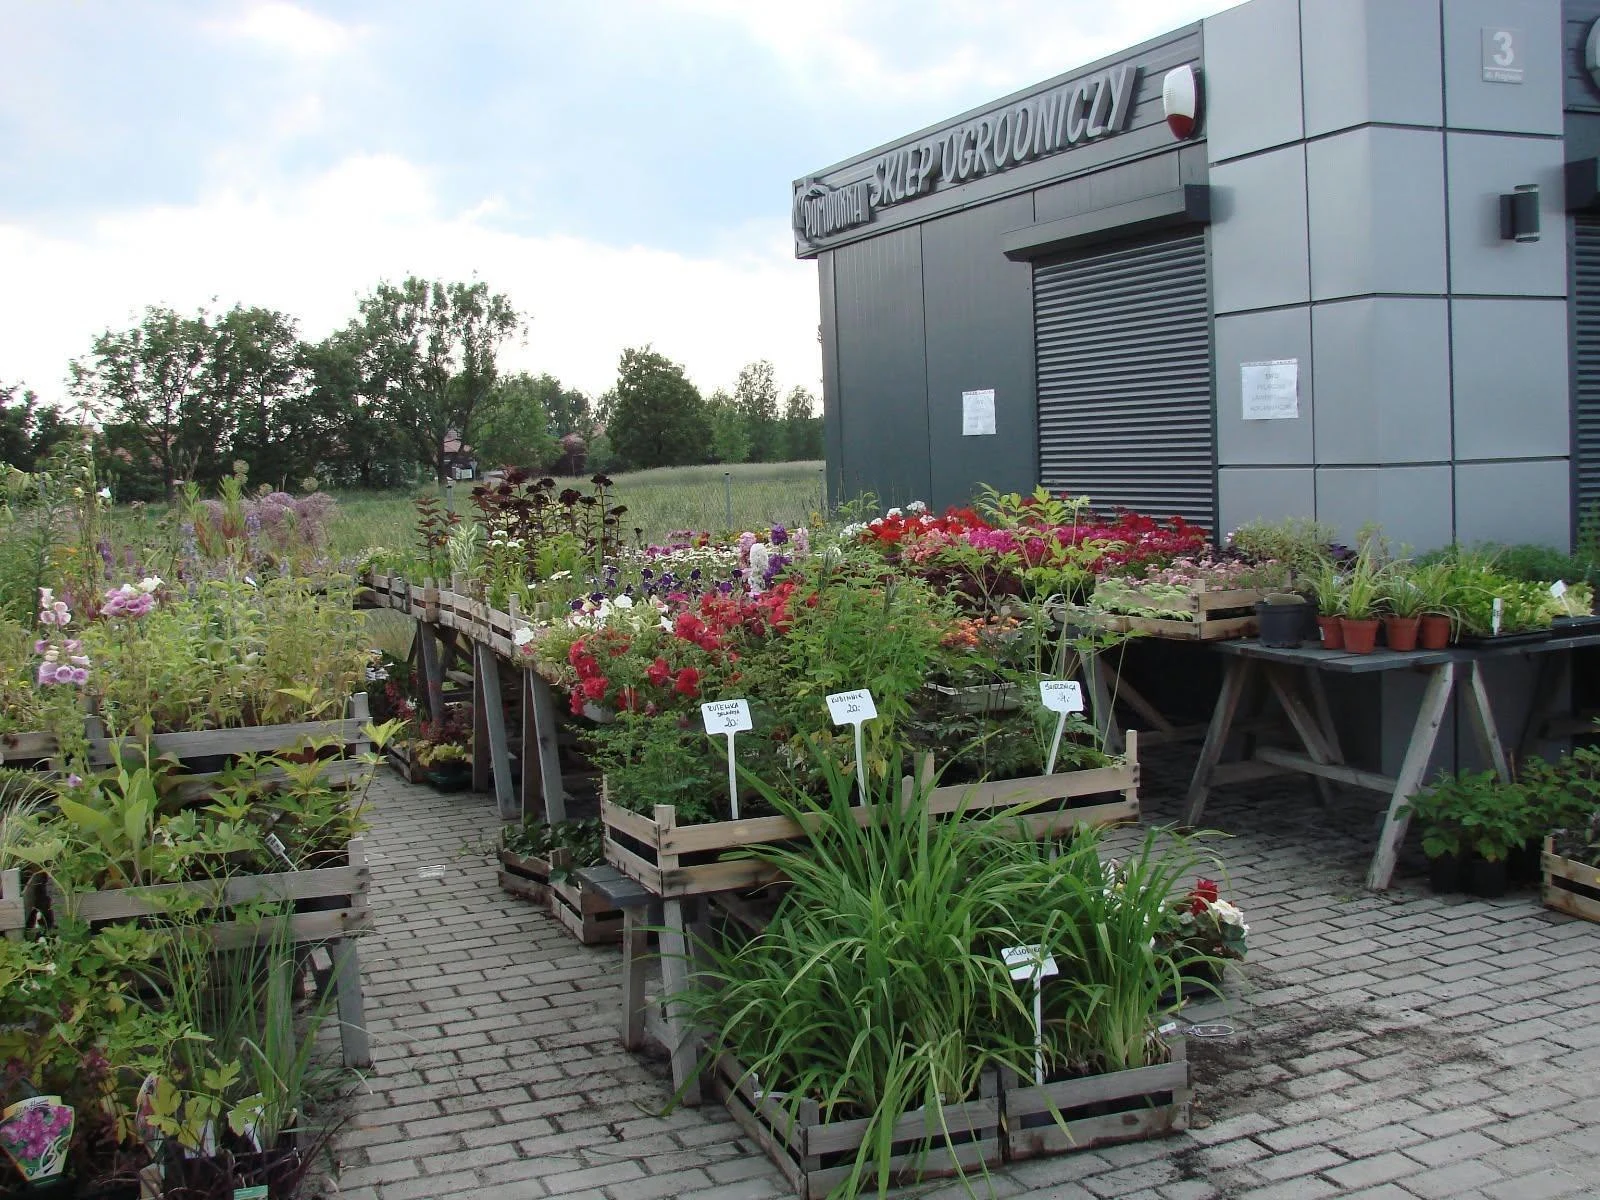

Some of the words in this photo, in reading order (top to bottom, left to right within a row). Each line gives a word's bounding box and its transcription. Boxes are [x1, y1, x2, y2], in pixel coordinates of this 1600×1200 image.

[1492, 31, 1515, 66] 3
[869, 143, 937, 207] SKLEP
[941, 64, 1136, 183] OGRODNICZY
